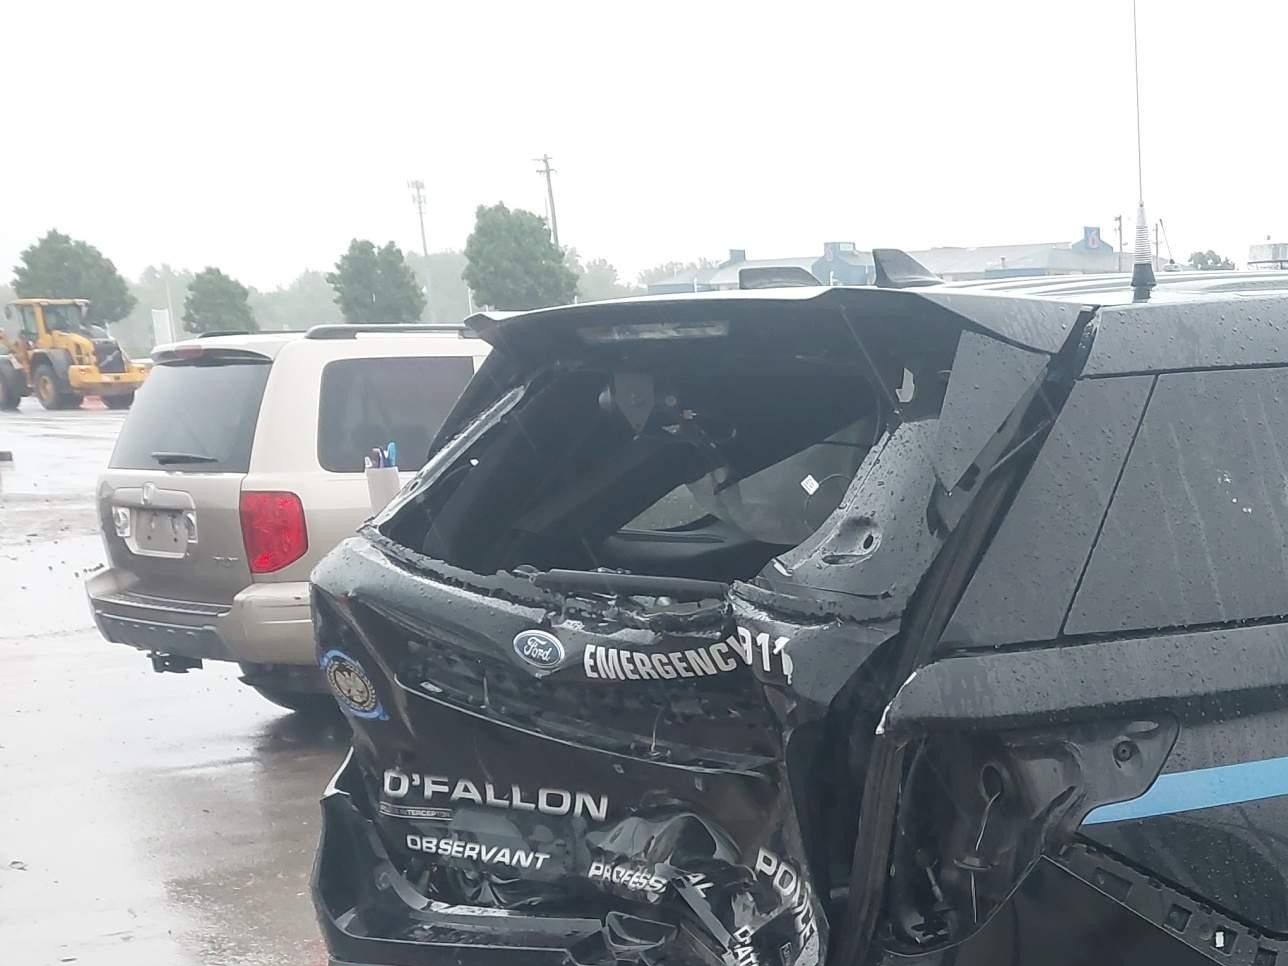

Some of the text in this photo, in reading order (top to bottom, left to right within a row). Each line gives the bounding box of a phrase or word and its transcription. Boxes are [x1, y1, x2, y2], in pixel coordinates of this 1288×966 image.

[524, 637, 551, 662] Ford
[383, 769, 609, 821] O'FALLON
[406, 834, 550, 870] OBSERVANT
